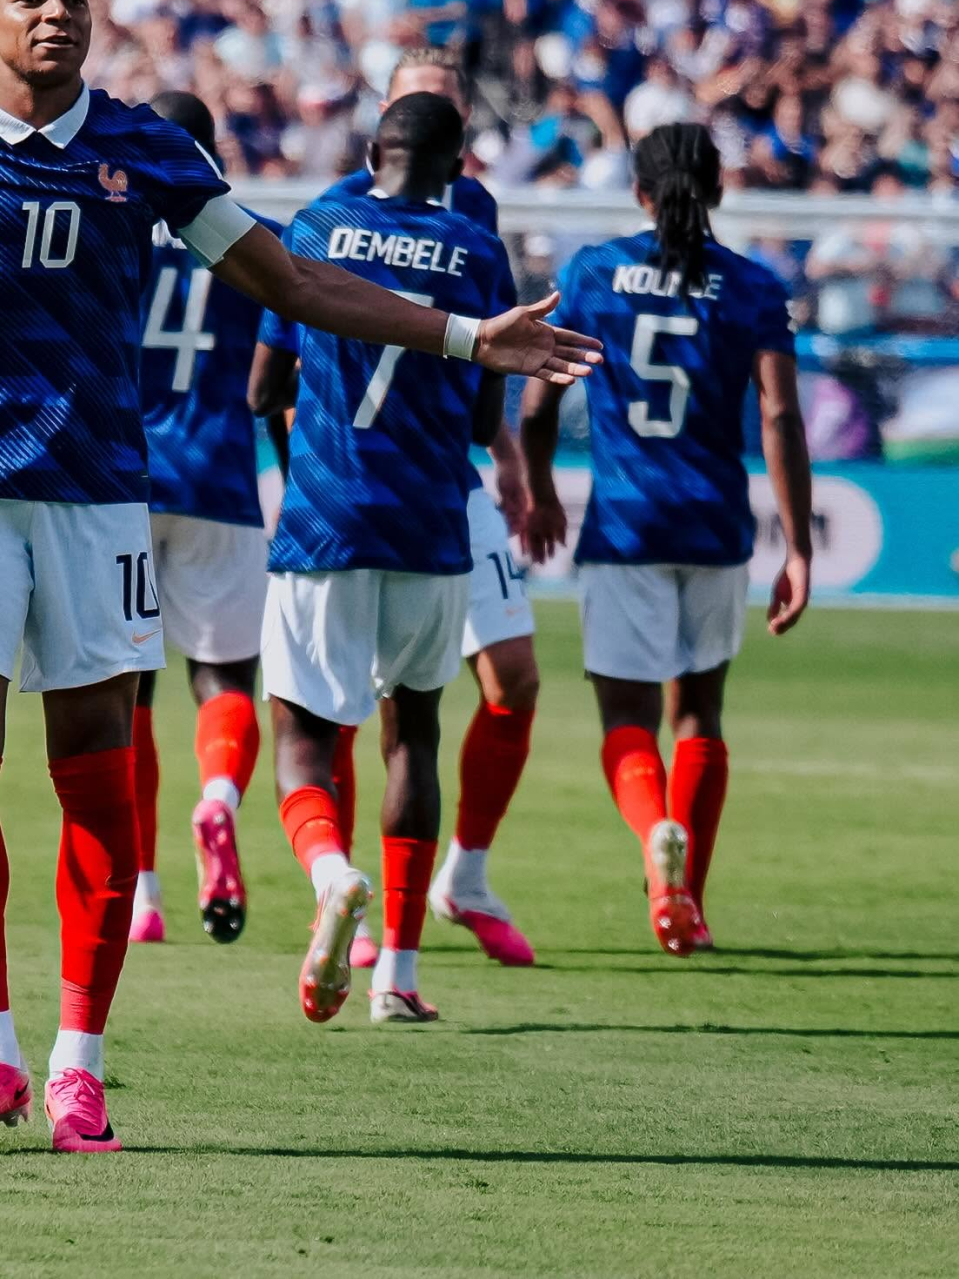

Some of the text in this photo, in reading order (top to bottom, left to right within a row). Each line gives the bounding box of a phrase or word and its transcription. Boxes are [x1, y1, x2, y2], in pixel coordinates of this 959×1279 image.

[21, 201, 81, 269] 10
[327, 227, 469, 277] DEMBELE
[141, 267, 215, 393] 4
[352, 289, 435, 430] 7
[628, 314, 699, 439] 5
[116, 551, 161, 621] 10
